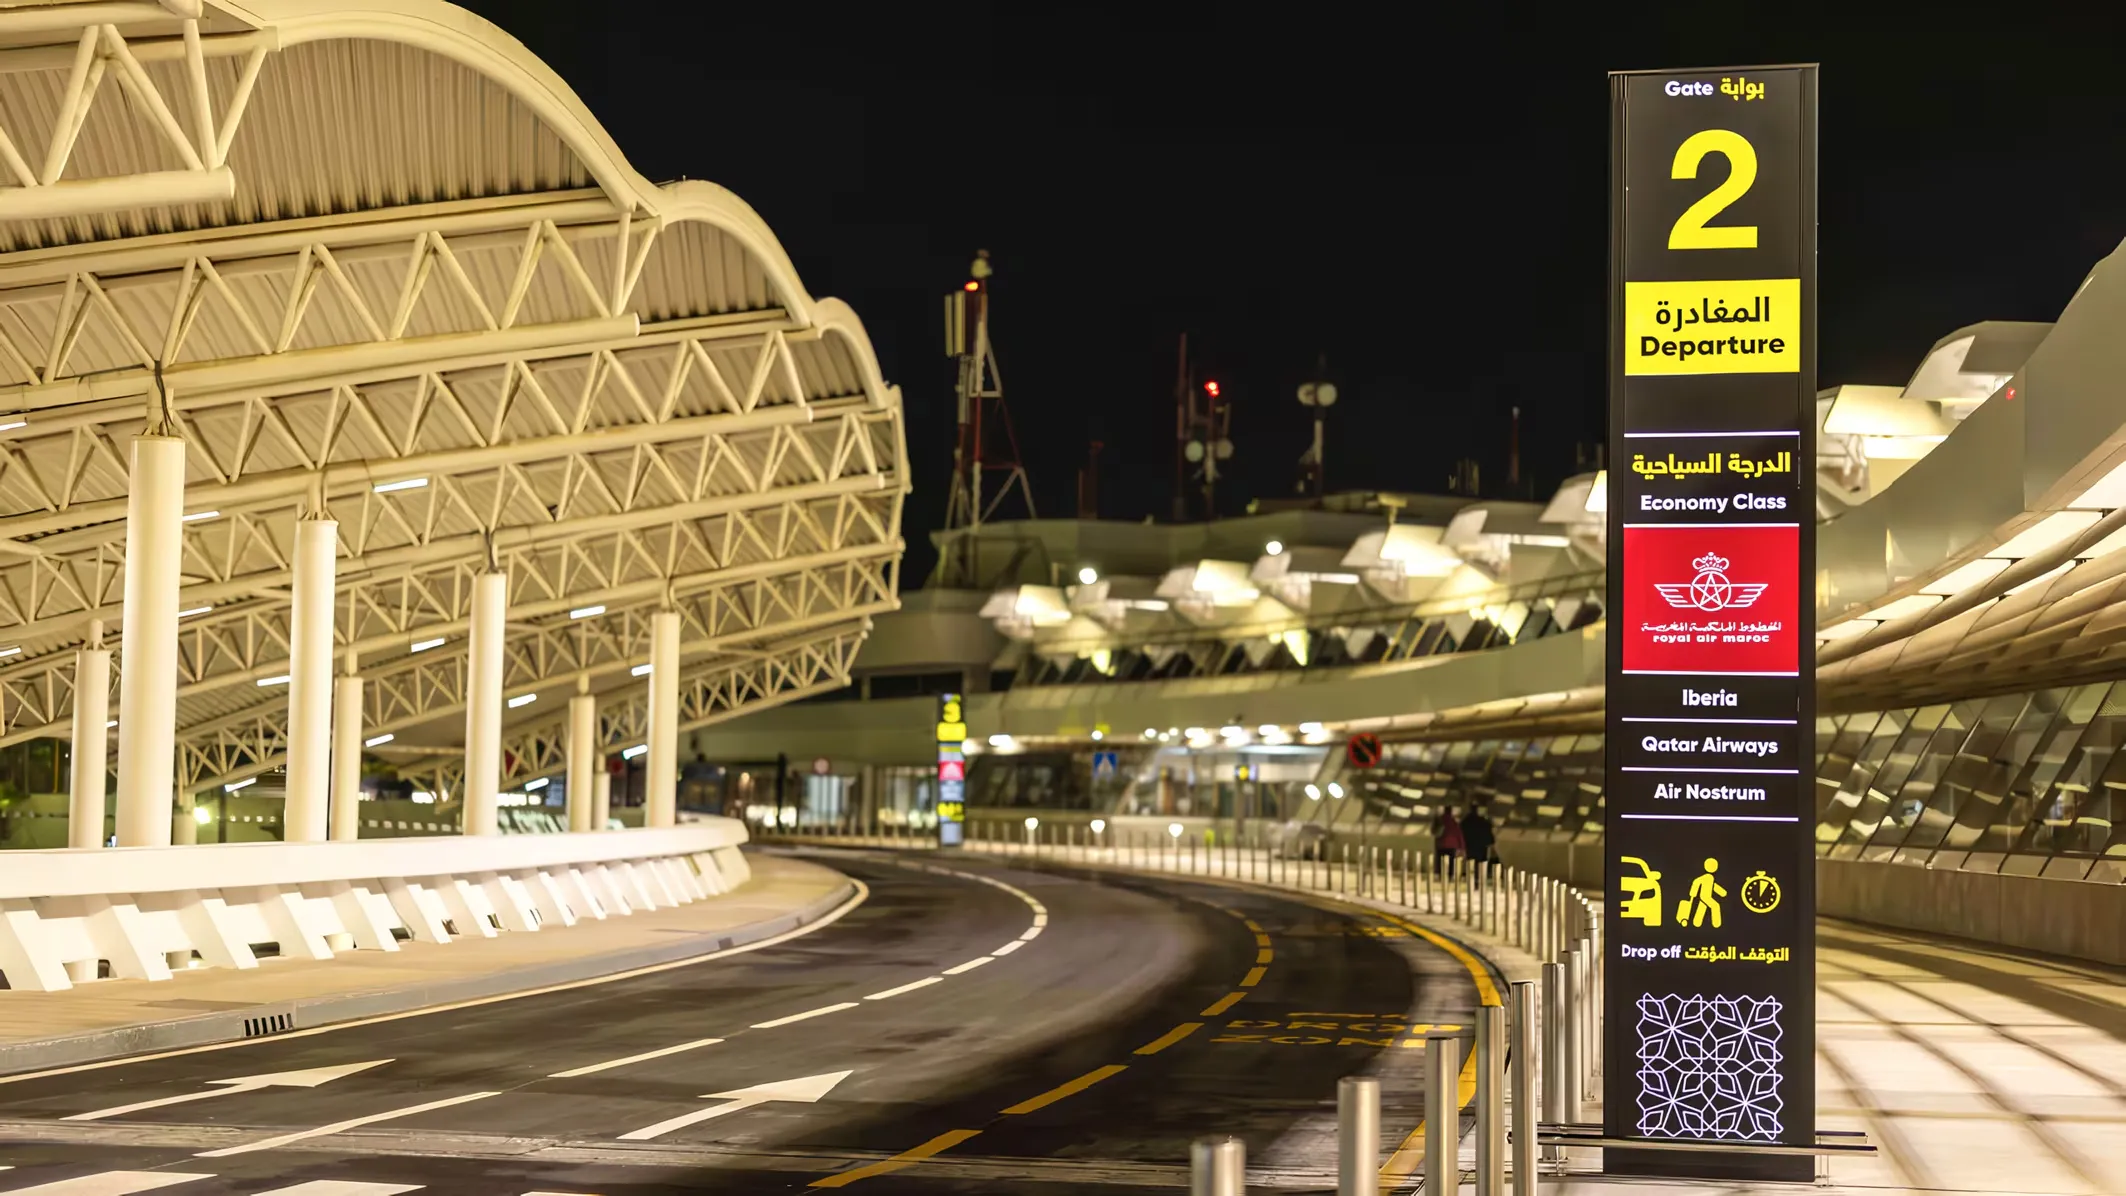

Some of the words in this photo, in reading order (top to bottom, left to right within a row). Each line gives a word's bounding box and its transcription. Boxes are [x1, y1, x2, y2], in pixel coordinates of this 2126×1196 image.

[1664, 80, 1714, 97] Gate
[1720, 76, 1765, 101] بوابة
[1667, 129, 1758, 250] 2
[1655, 296, 1770, 333] المغادرة
[1640, 335, 1785, 361] Departure
[1631, 452, 1722, 480] السياحية
[1727, 451, 1791, 479] الدرجة
[1640, 494, 1728, 514] Economy
[1732, 492, 1787, 510] Class
[1652, 633, 1691, 644] royal
[1696, 633, 1718, 643] air
[1722, 634, 1770, 643] maroc
[1682, 688, 1738, 707] Iberia
[1641, 735, 1699, 752] Qatar
[1701, 736, 1779, 757] Airways
[1653, 783, 1682, 800] Air
[1685, 783, 1766, 801] Nostrum
[1621, 943, 1658, 961] Drop
[1660, 944, 1682, 958] off
[1684, 945, 1737, 962] المؤقت
[1739, 947, 1790, 964] التوقف
[1225, 1020, 1463, 1034] DROP
